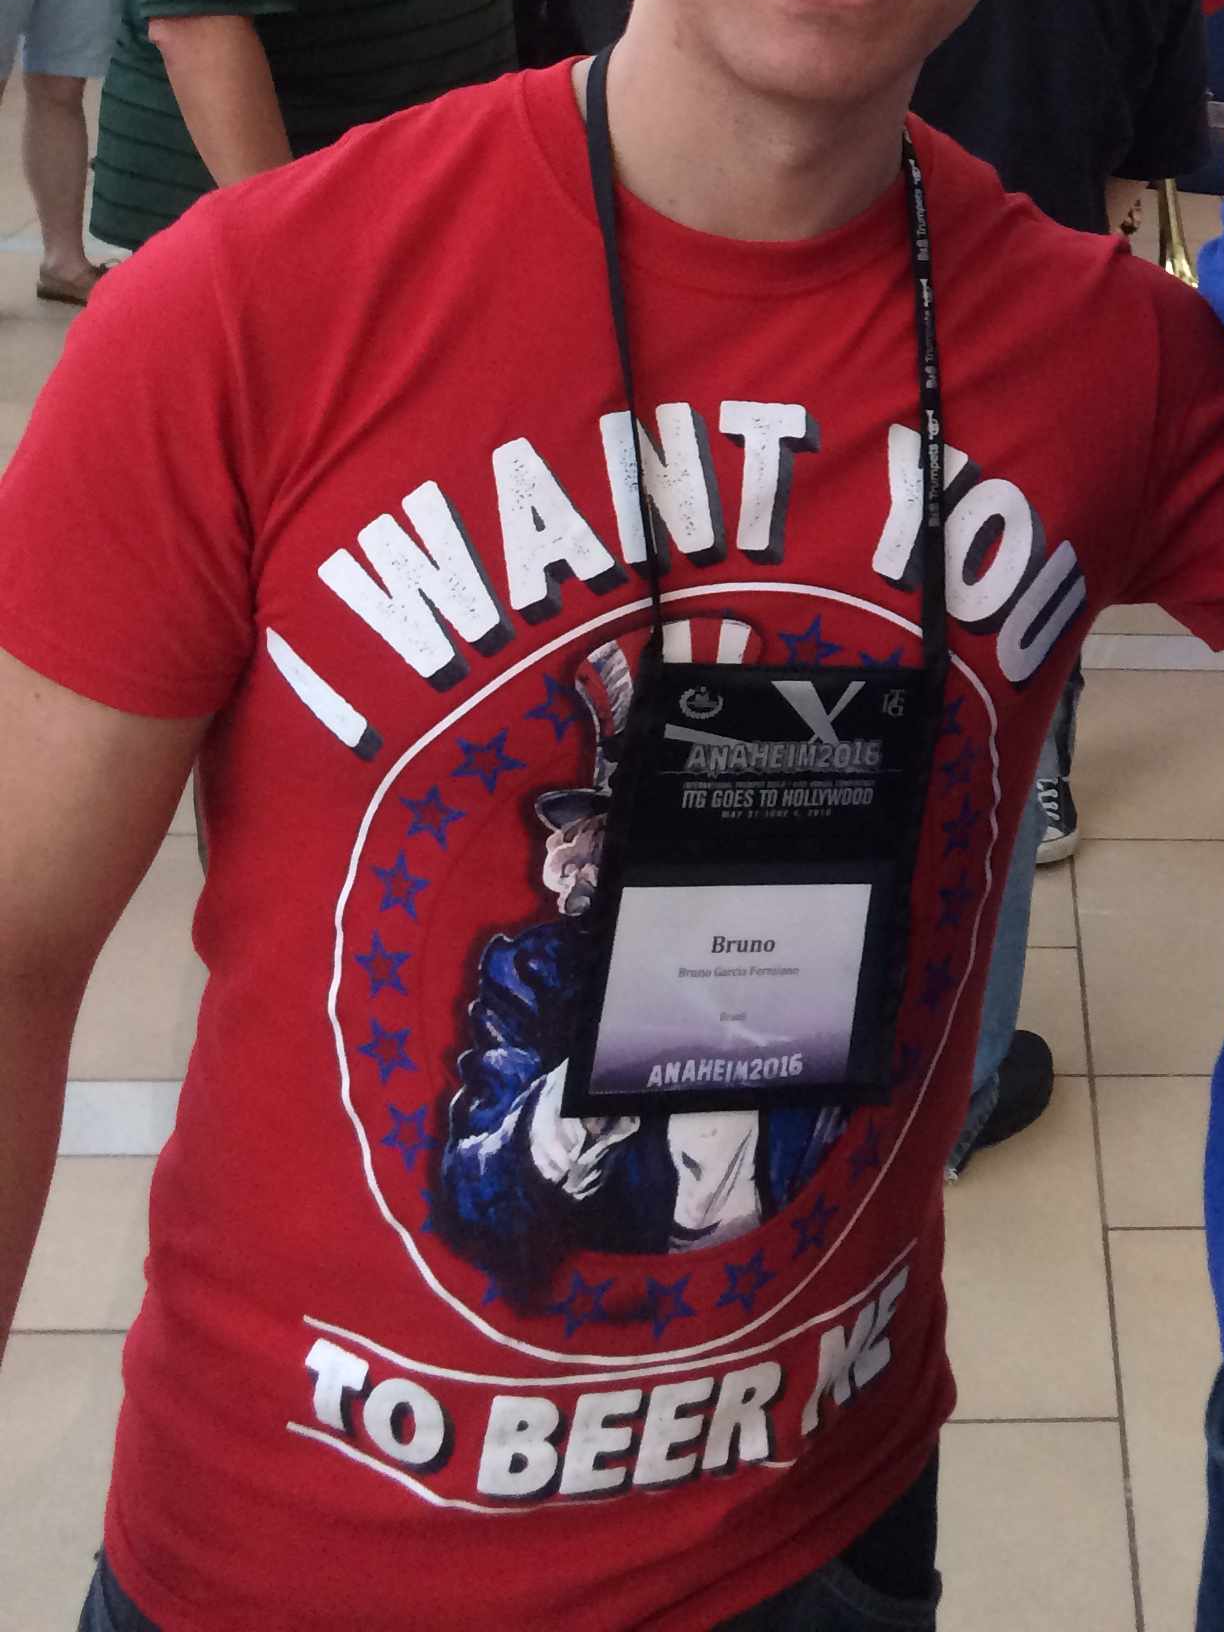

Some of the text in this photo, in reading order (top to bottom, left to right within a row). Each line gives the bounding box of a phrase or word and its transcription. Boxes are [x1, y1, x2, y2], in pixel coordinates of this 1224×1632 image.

[266, 401, 1085, 751] I WANT YOU
[686, 740, 882, 772] ANAHEIM2016
[681, 787, 874, 809] ITG GOES TO HOLLYWOOD
[711, 935, 777, 954] Bruno
[677, 966, 712, 978] Bruno
[646, 1052, 804, 1088] ANAHEIM2016
[303, 1337, 446, 1466] TO
[476, 1360, 783, 1498] BEER
